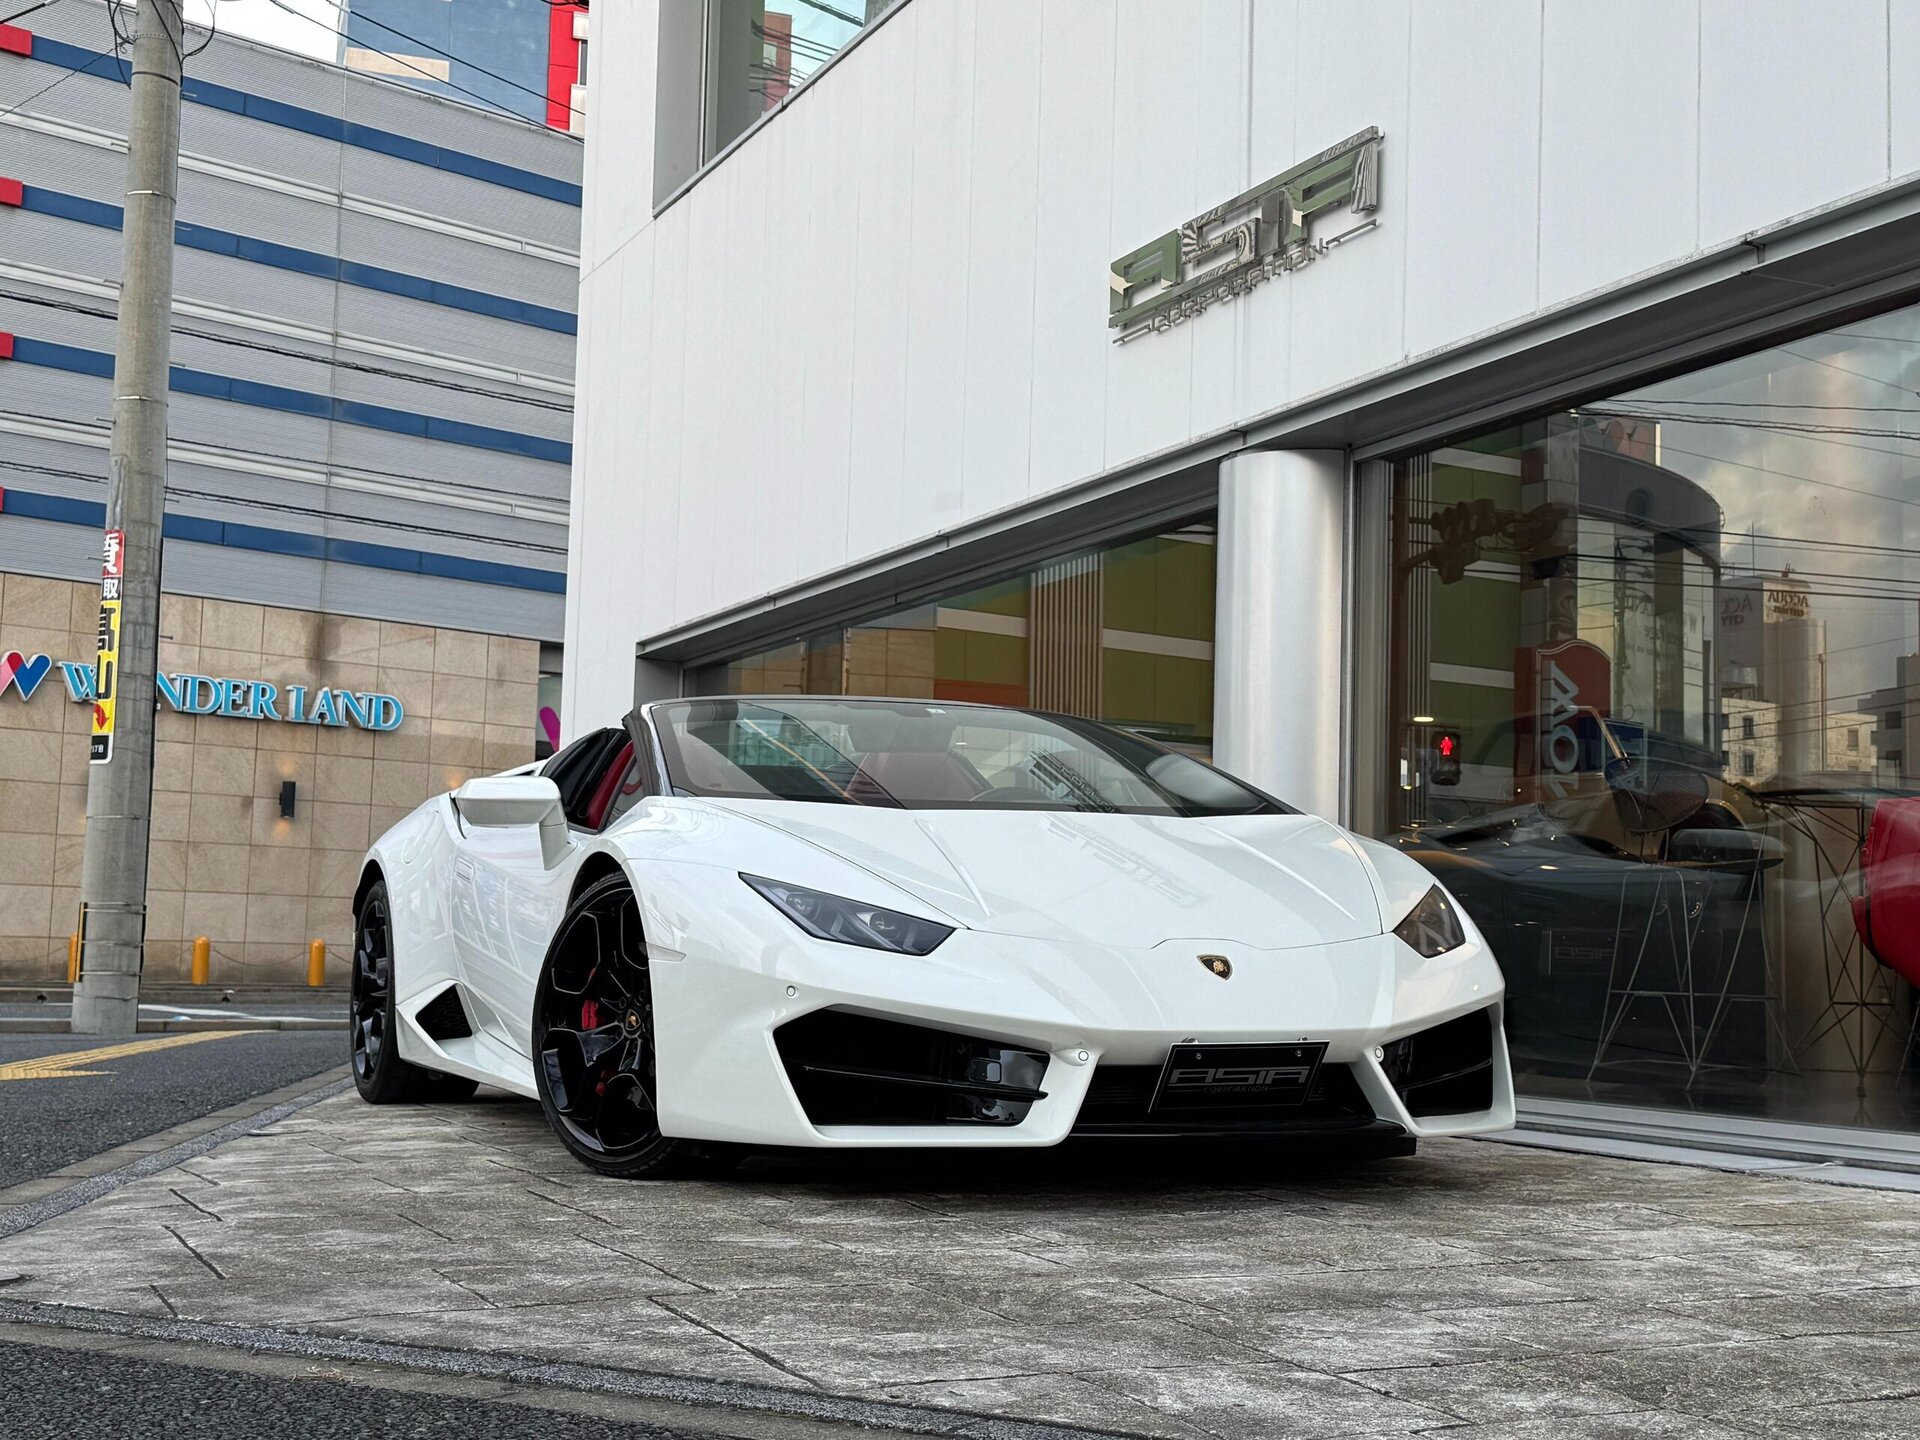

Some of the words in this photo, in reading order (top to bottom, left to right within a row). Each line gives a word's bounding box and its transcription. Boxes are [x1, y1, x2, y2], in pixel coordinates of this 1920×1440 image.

[1108, 125, 1378, 329] ASIA
[56, 661, 282, 721] WNDER
[1168, 1066, 1310, 1087] ASIA
